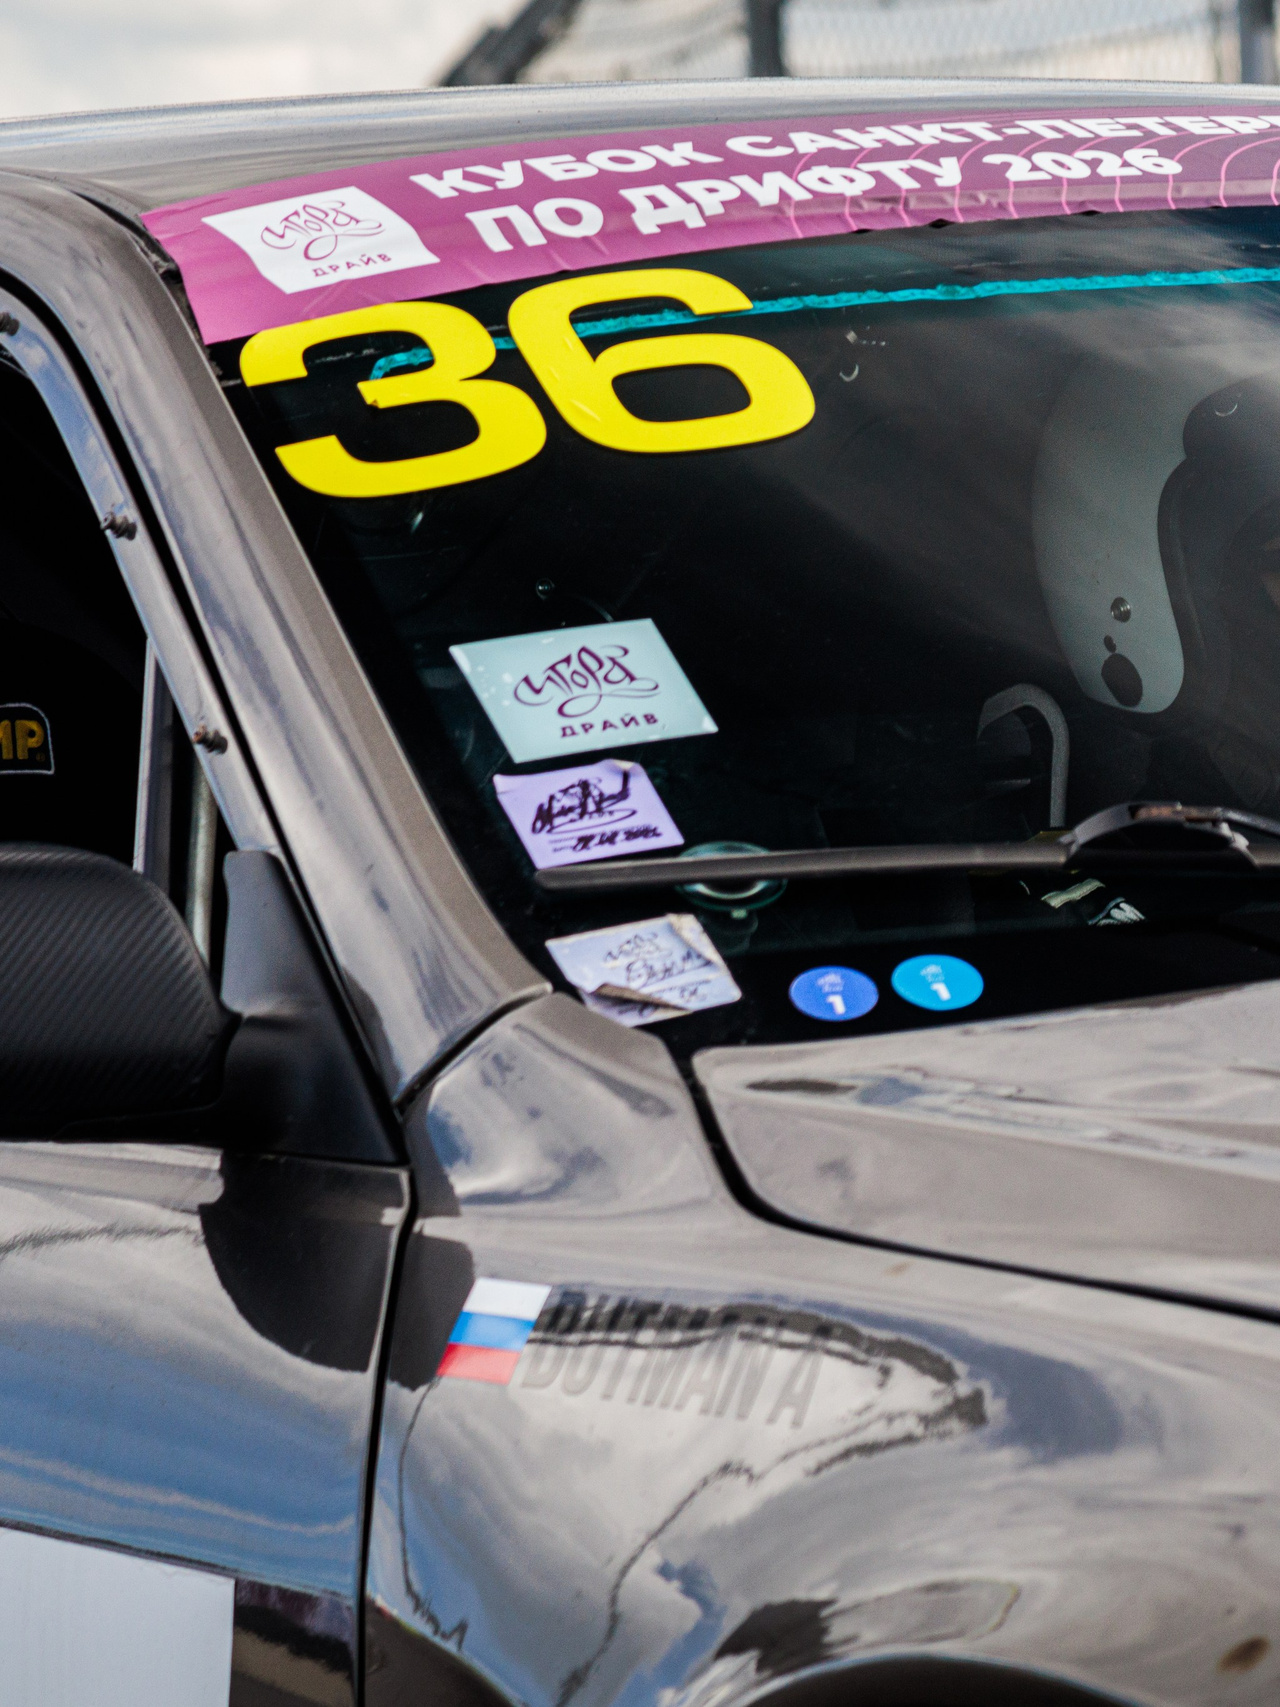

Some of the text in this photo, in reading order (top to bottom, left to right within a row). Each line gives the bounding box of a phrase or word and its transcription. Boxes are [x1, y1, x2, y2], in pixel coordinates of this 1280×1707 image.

[410, 141, 724, 198] КУБОК
[466, 147, 1183, 253] ПО ДРИФТУ 2026
[312, 253, 392, 277] ДРАЙВ
[239, 268, 816, 498] 36
[560, 713, 659, 738] ДРАЙВ
[930, 982, 951, 1001] 1
[826, 994, 846, 1015] 1
